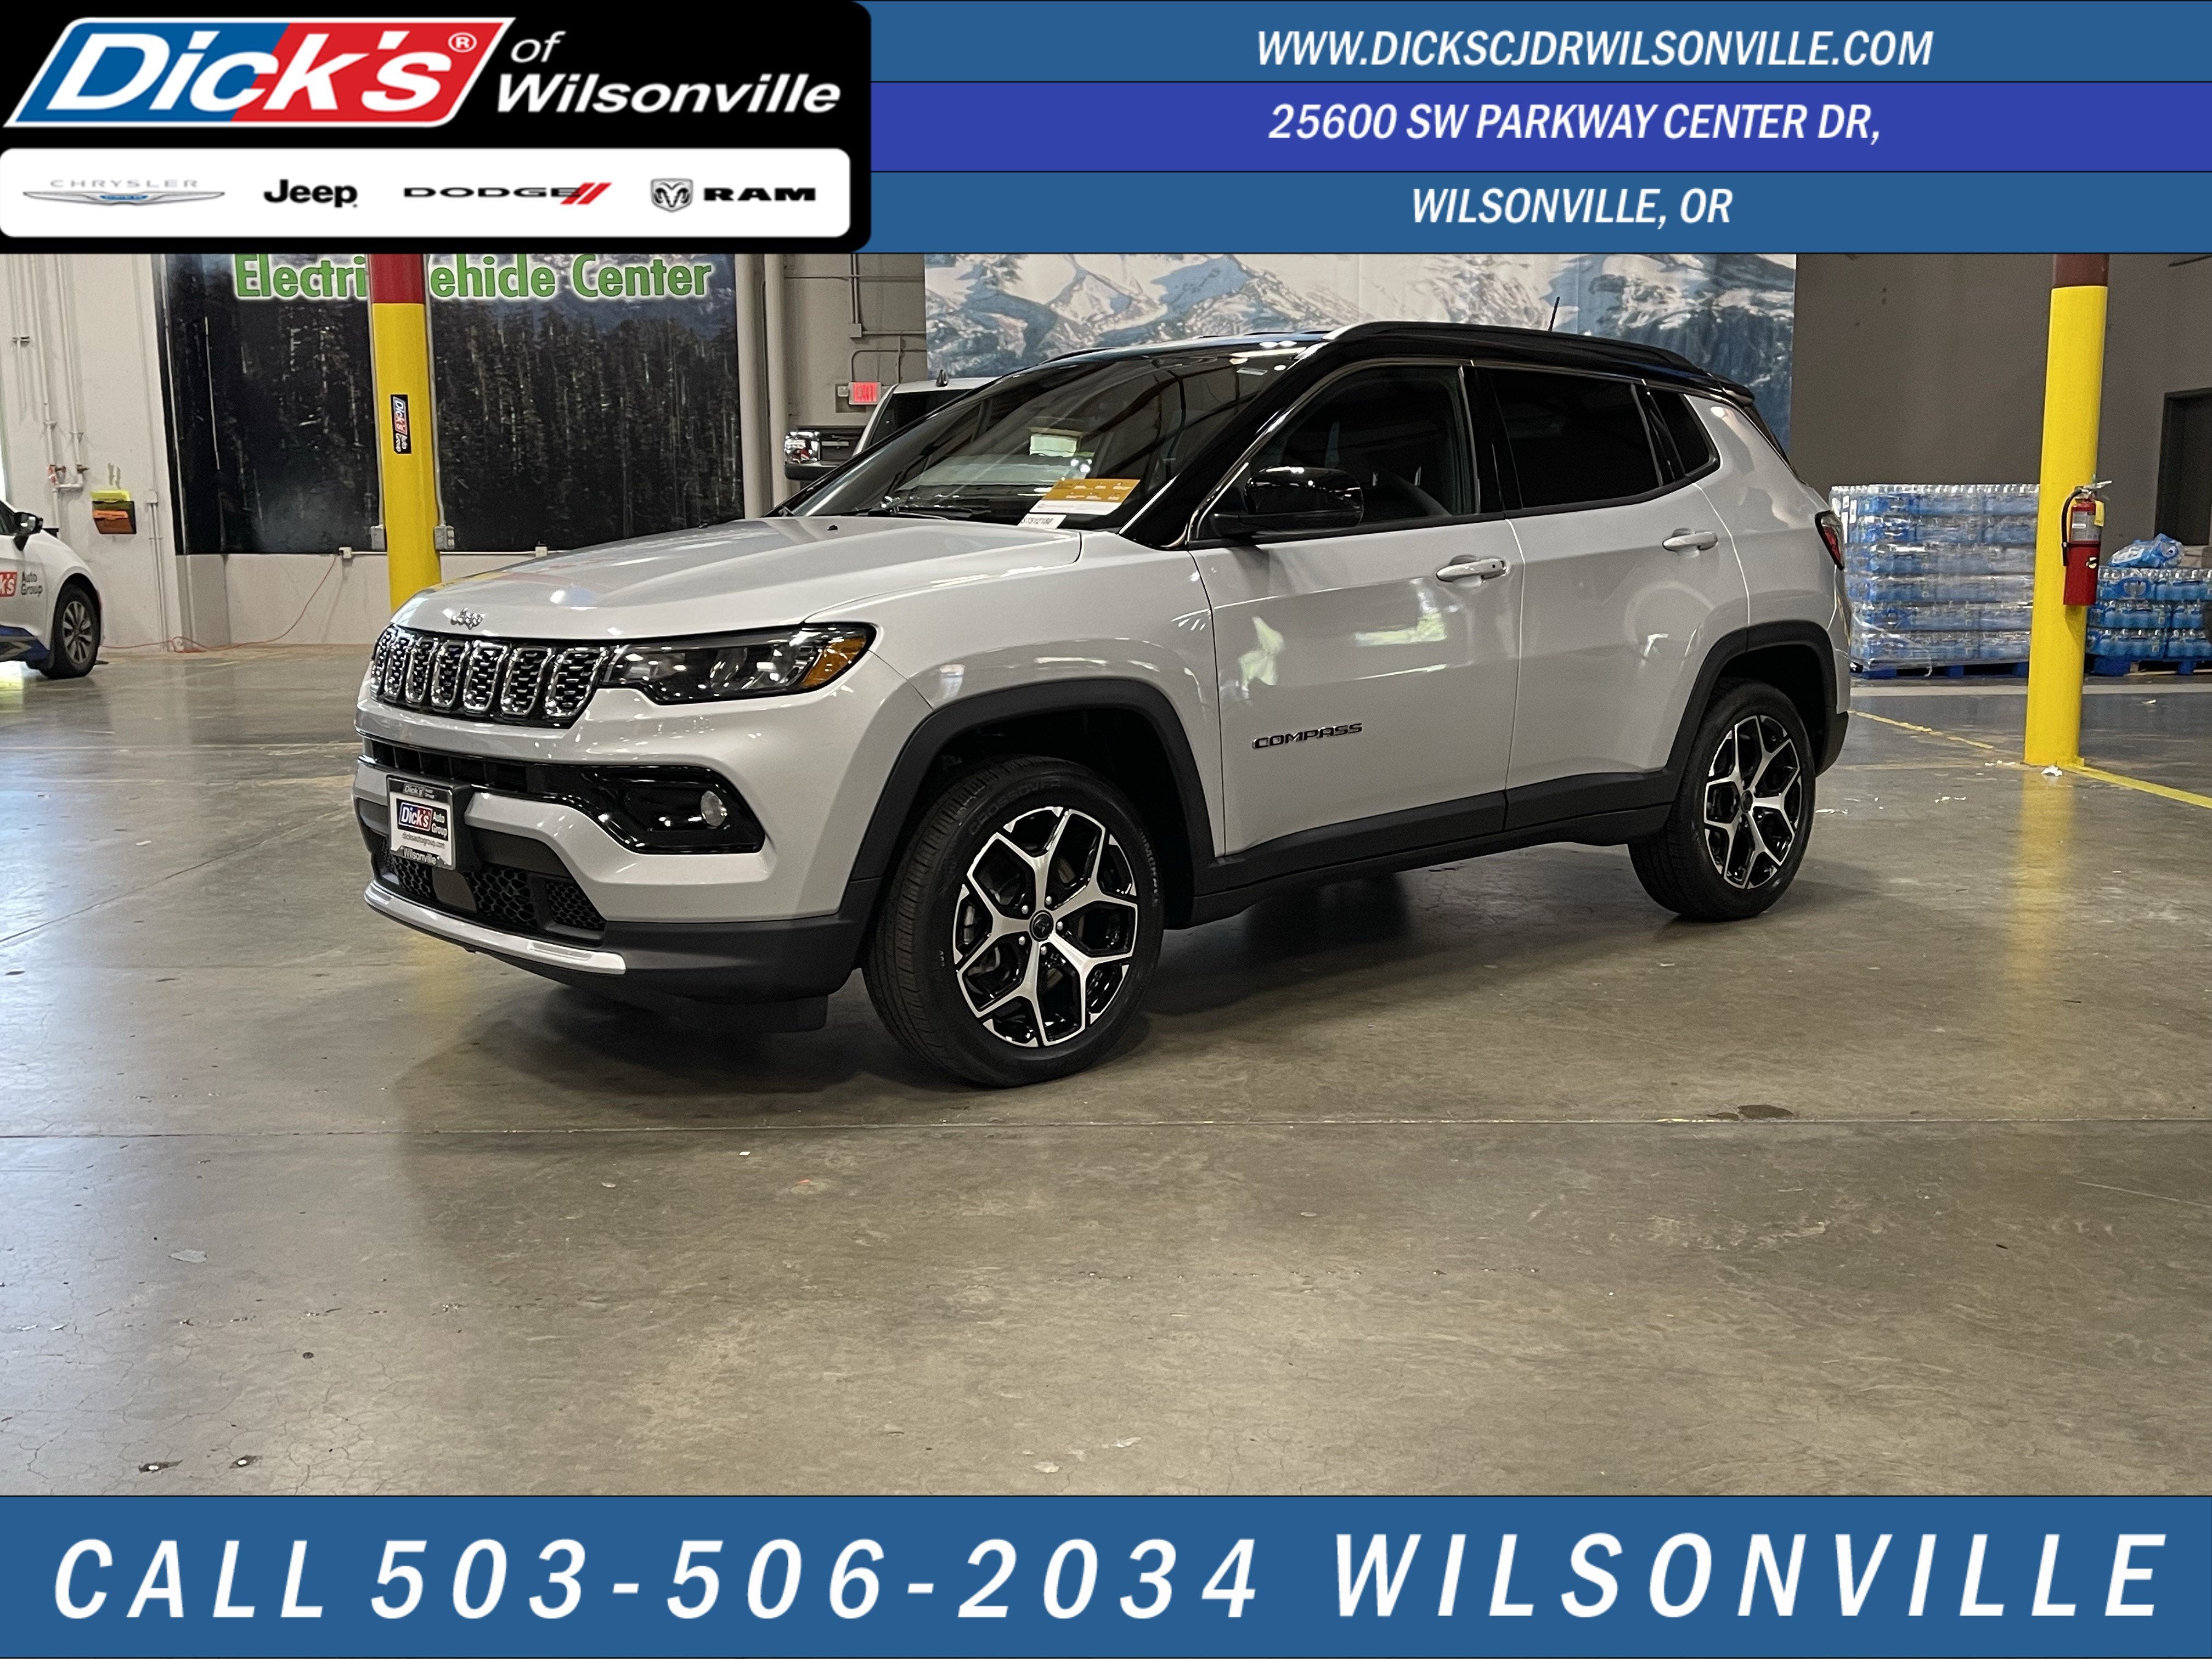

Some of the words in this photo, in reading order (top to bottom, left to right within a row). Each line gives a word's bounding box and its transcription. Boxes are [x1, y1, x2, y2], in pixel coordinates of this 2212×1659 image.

[234, 254, 366, 297] Electri
[430, 254, 555, 297] ehicle
[573, 254, 712, 297] Center
[1252, 723, 1363, 750] COMPASS
[401, 806, 430, 828] Dick's
